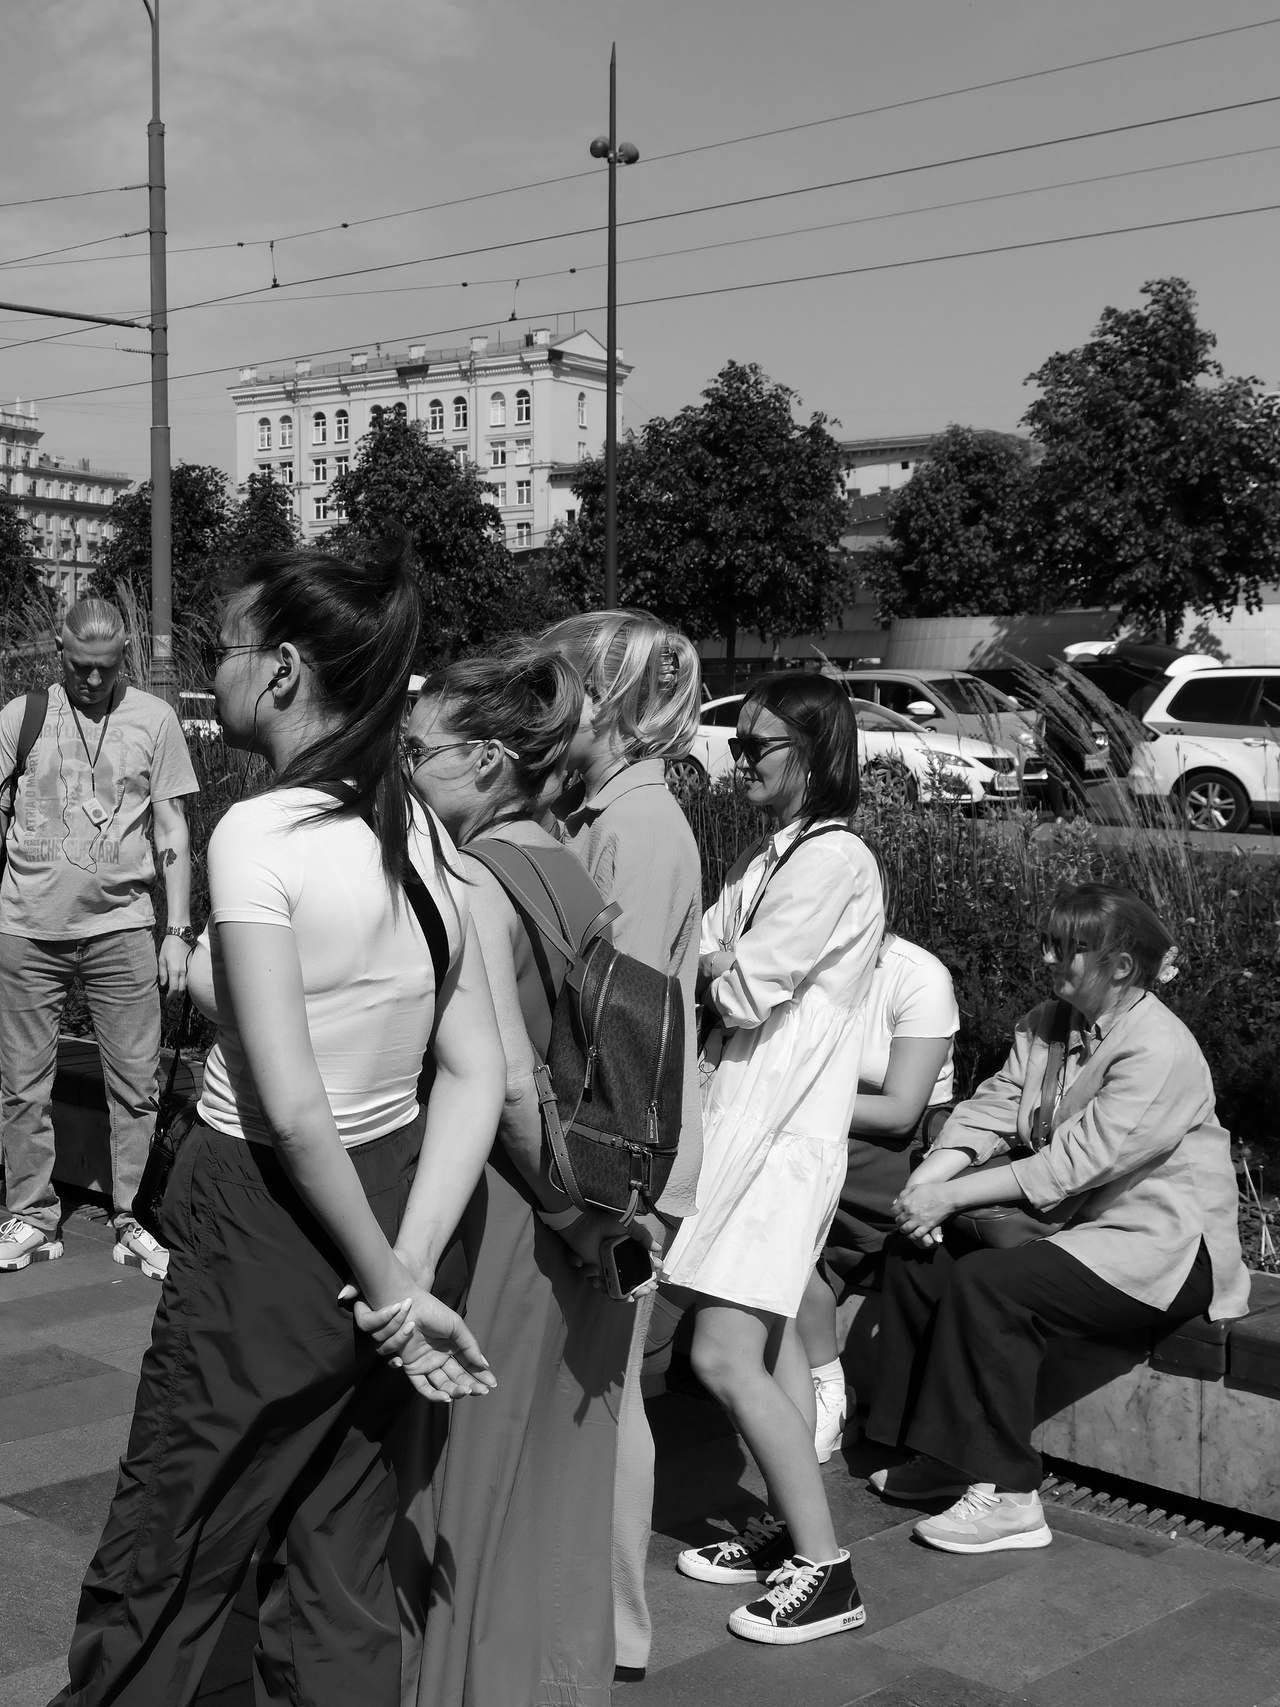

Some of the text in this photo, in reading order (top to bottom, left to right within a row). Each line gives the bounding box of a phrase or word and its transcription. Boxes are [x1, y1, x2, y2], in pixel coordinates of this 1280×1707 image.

[25, 790, 36, 798] O
[25, 801, 36, 837] PATRIA
[23, 839, 40, 847] PEACE
[40, 839, 61, 862] CHE
